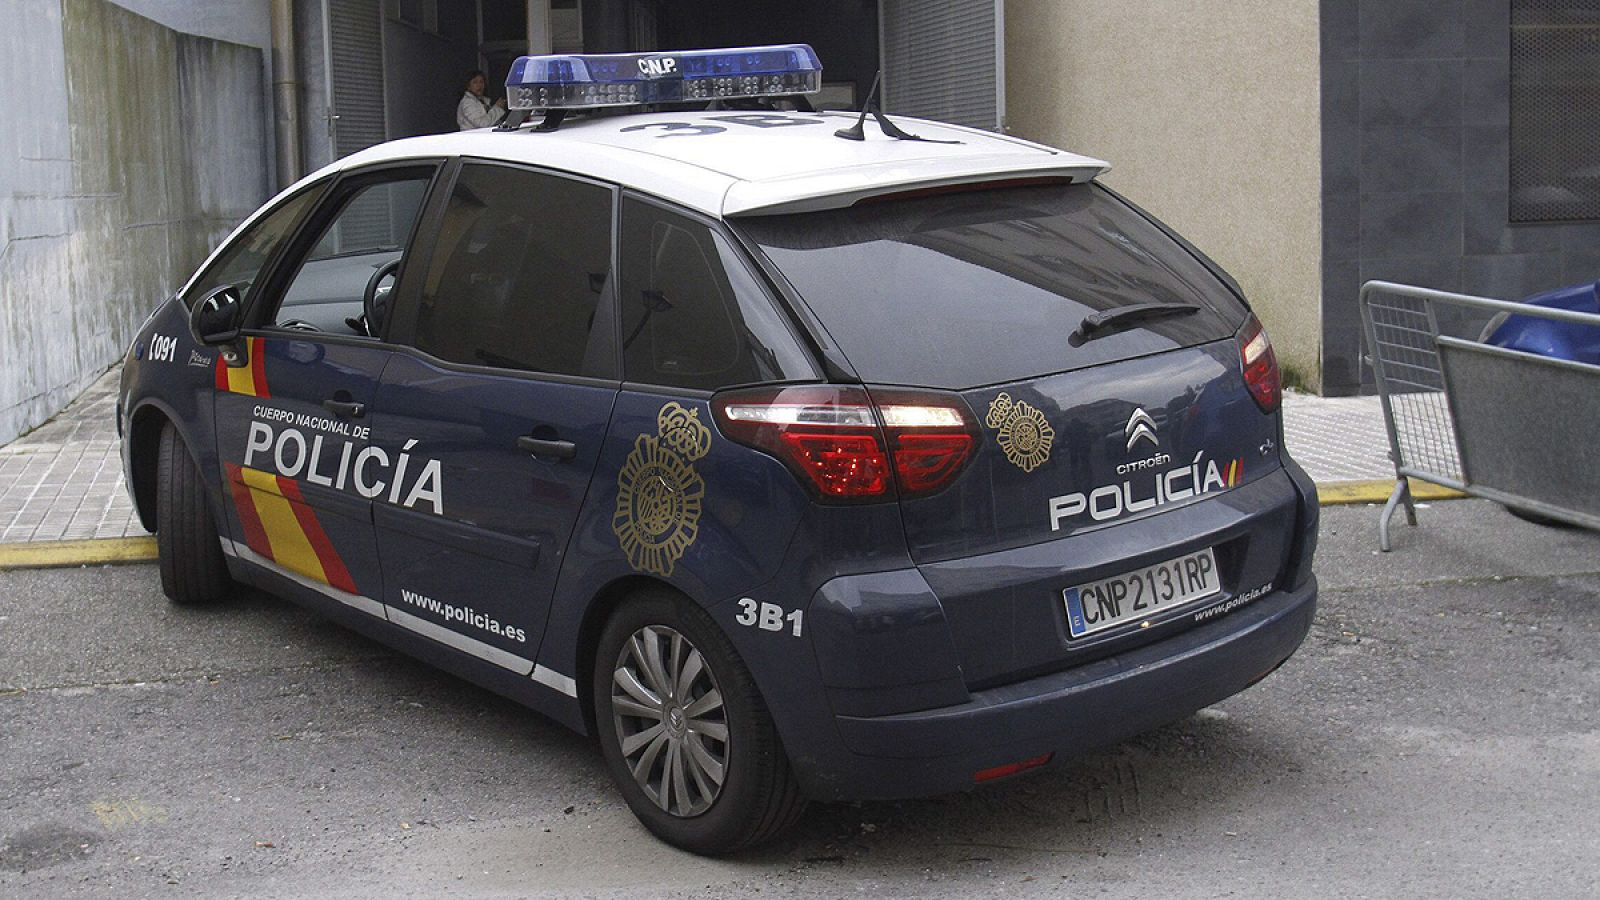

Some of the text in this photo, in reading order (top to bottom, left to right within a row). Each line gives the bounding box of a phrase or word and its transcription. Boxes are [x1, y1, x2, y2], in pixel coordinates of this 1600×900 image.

[154, 335, 178, 362] 091
[253, 405, 371, 440] CUERPO NACIONAL DE
[243, 420, 444, 516] POLICÍA
[1049, 450, 1225, 532] POLICÍA
[1080, 554, 1212, 625] CNP2131RP
[1195, 582, 1273, 623] www.policia.es
[401, 589, 527, 642] www.policia.es
[735, 597, 804, 637] 3B1
